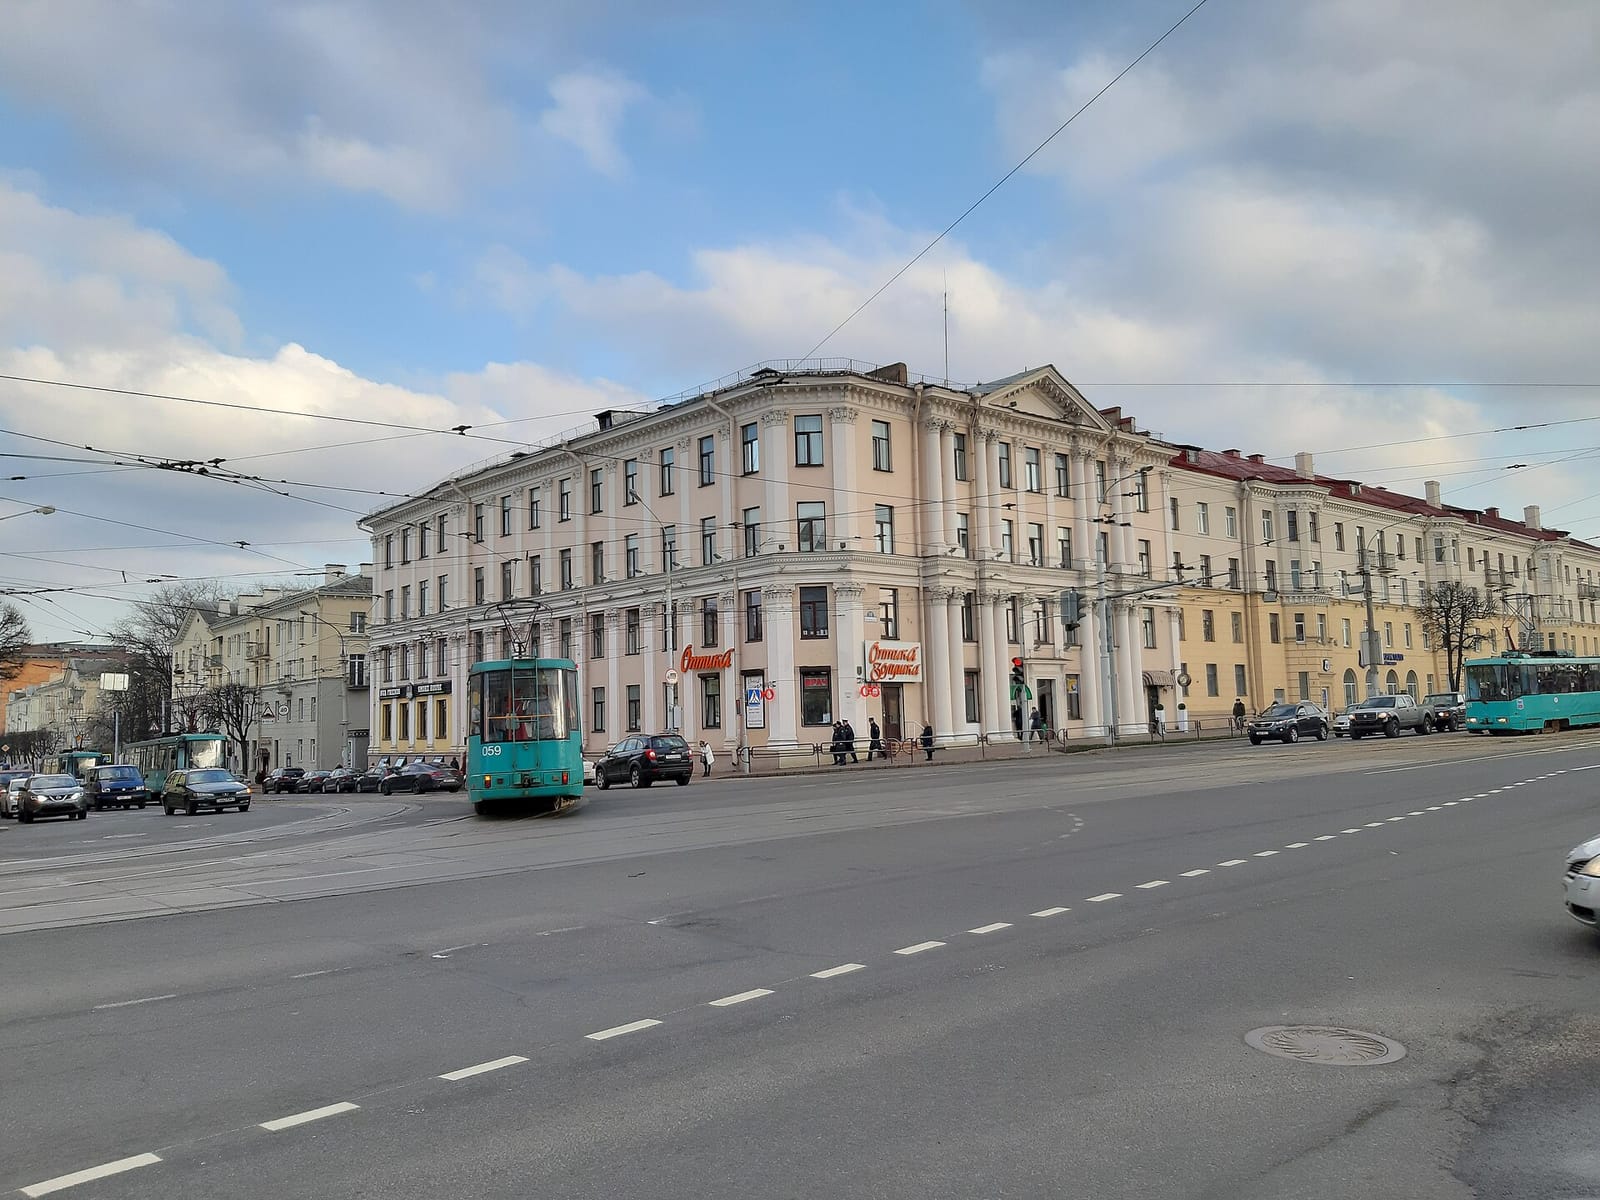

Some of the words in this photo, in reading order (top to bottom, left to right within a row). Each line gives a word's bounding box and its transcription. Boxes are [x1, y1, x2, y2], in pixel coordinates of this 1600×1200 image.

[681, 644, 735, 672] Оптика
[869, 642, 918, 664] Оптика
[482, 745, 501, 756] 059
